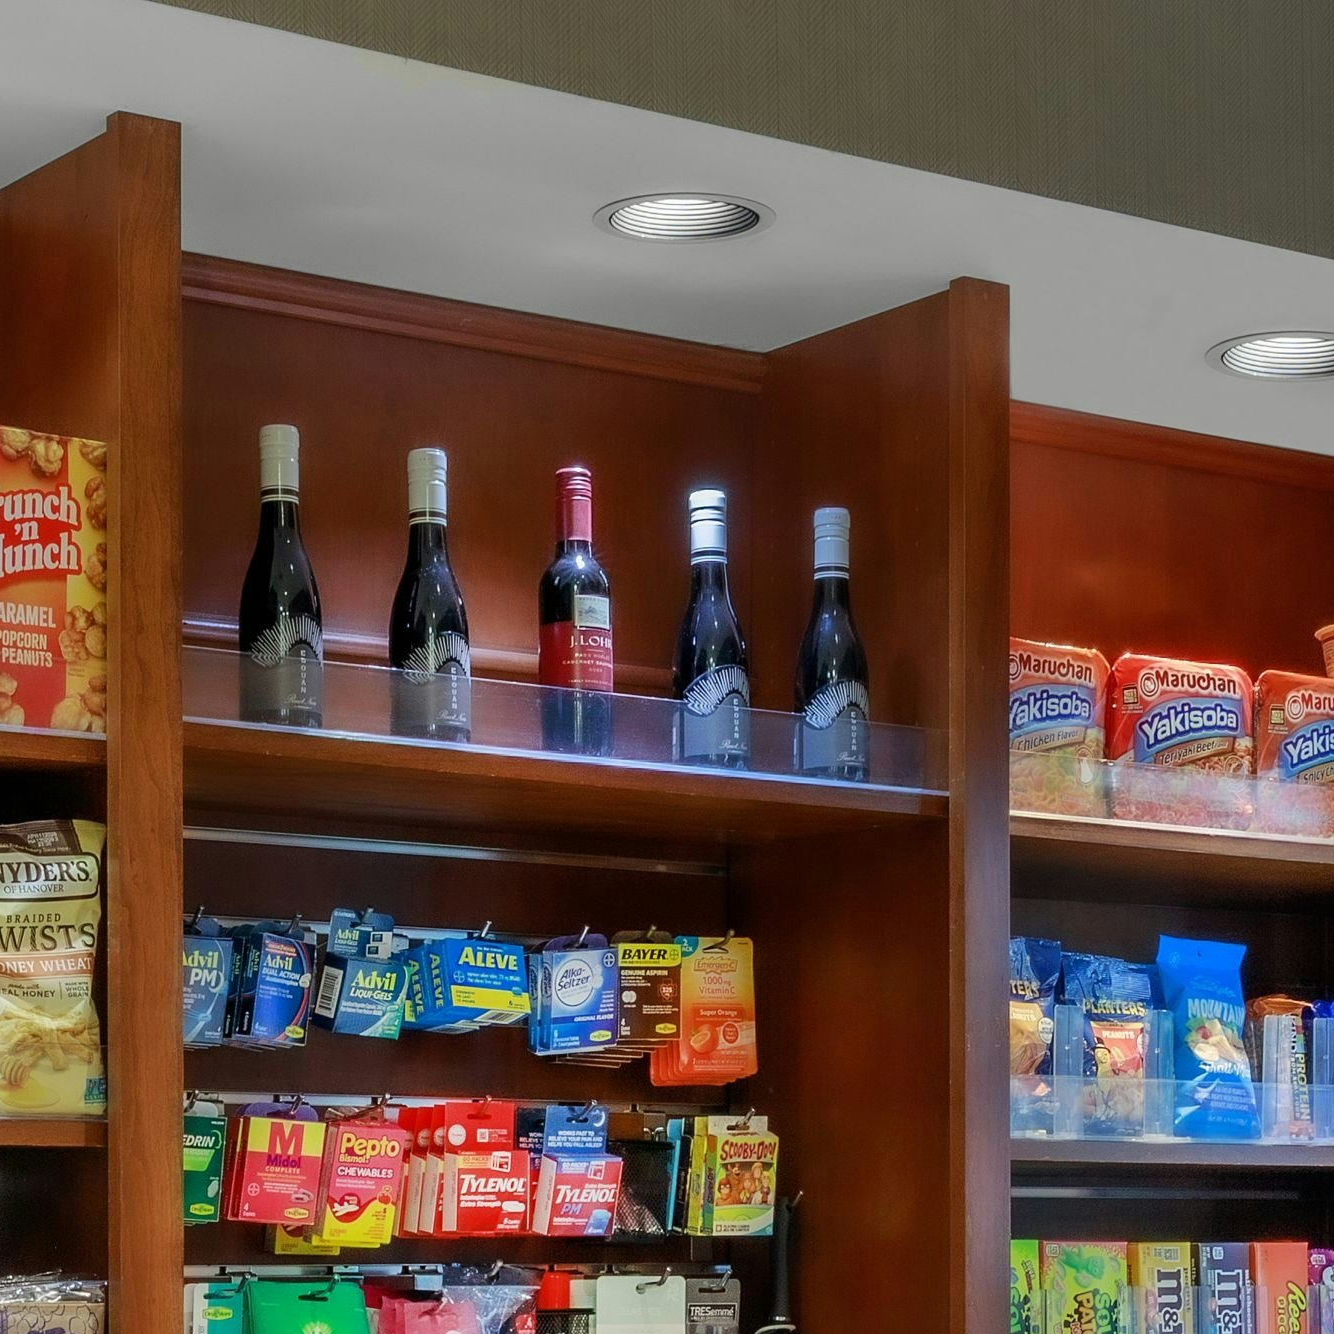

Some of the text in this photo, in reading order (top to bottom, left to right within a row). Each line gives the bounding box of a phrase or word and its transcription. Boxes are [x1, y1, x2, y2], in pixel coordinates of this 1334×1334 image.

[15, 520, 39, 541] 'n
[1, 648, 54, 668] PEANUTS
[1018, 655, 1093, 684] Maruchan
[1158, 672, 1238, 695] Maruchan
[1010, 691, 1091, 730] Yakisoba
[1141, 706, 1238, 748] Yakisoba
[1160, 740, 1215, 766] Teriyaki Beef
[3, 884, 64, 895] OF HANOVER
[6, 913, 62, 924] BRAIDED
[334, 928, 361, 942] Advil
[182, 950, 218, 970] Advil
[263, 953, 294, 972] Advil
[457, 945, 519, 972] ALEVE
[621, 948, 668, 960] BAYER
[38, 957, 93, 973] WHEAT
[261, 967, 301, 981] DUAL ACTION
[696, 960, 736, 972] Emergen-C
[189, 969, 217, 987] PM
[350, 968, 398, 993] Advil
[429, 952, 443, 1011] ALEVE
[556, 974, 592, 992] Seltzer
[22, 989, 56, 998] HONEY
[67, 991, 90, 999] GRAIN
[349, 986, 394, 1002] LIQUI-GELS
[698, 986, 729, 995] Vitamin
[699, 1009, 738, 1018] Super Orange
[1083, 999, 1146, 1018] PLANTERS
[1101, 1030, 1136, 1040] PEANUTS
[1295, 1053, 1311, 1121] PROTEIN
[268, 1121, 305, 1155] M
[340, 1132, 401, 1158] Pepto
[719, 1138, 777, 1162] SCOOBY-DOO!
[264, 1165, 301, 1175] COMPLETE
[266, 1154, 302, 1169] Midol
[336, 1166, 395, 1179] CHEWABLES
[459, 1174, 527, 1195] TYLENOL
[555, 1184, 618, 1204] TYLENOL
[560, 1203, 583, 1215] PM
